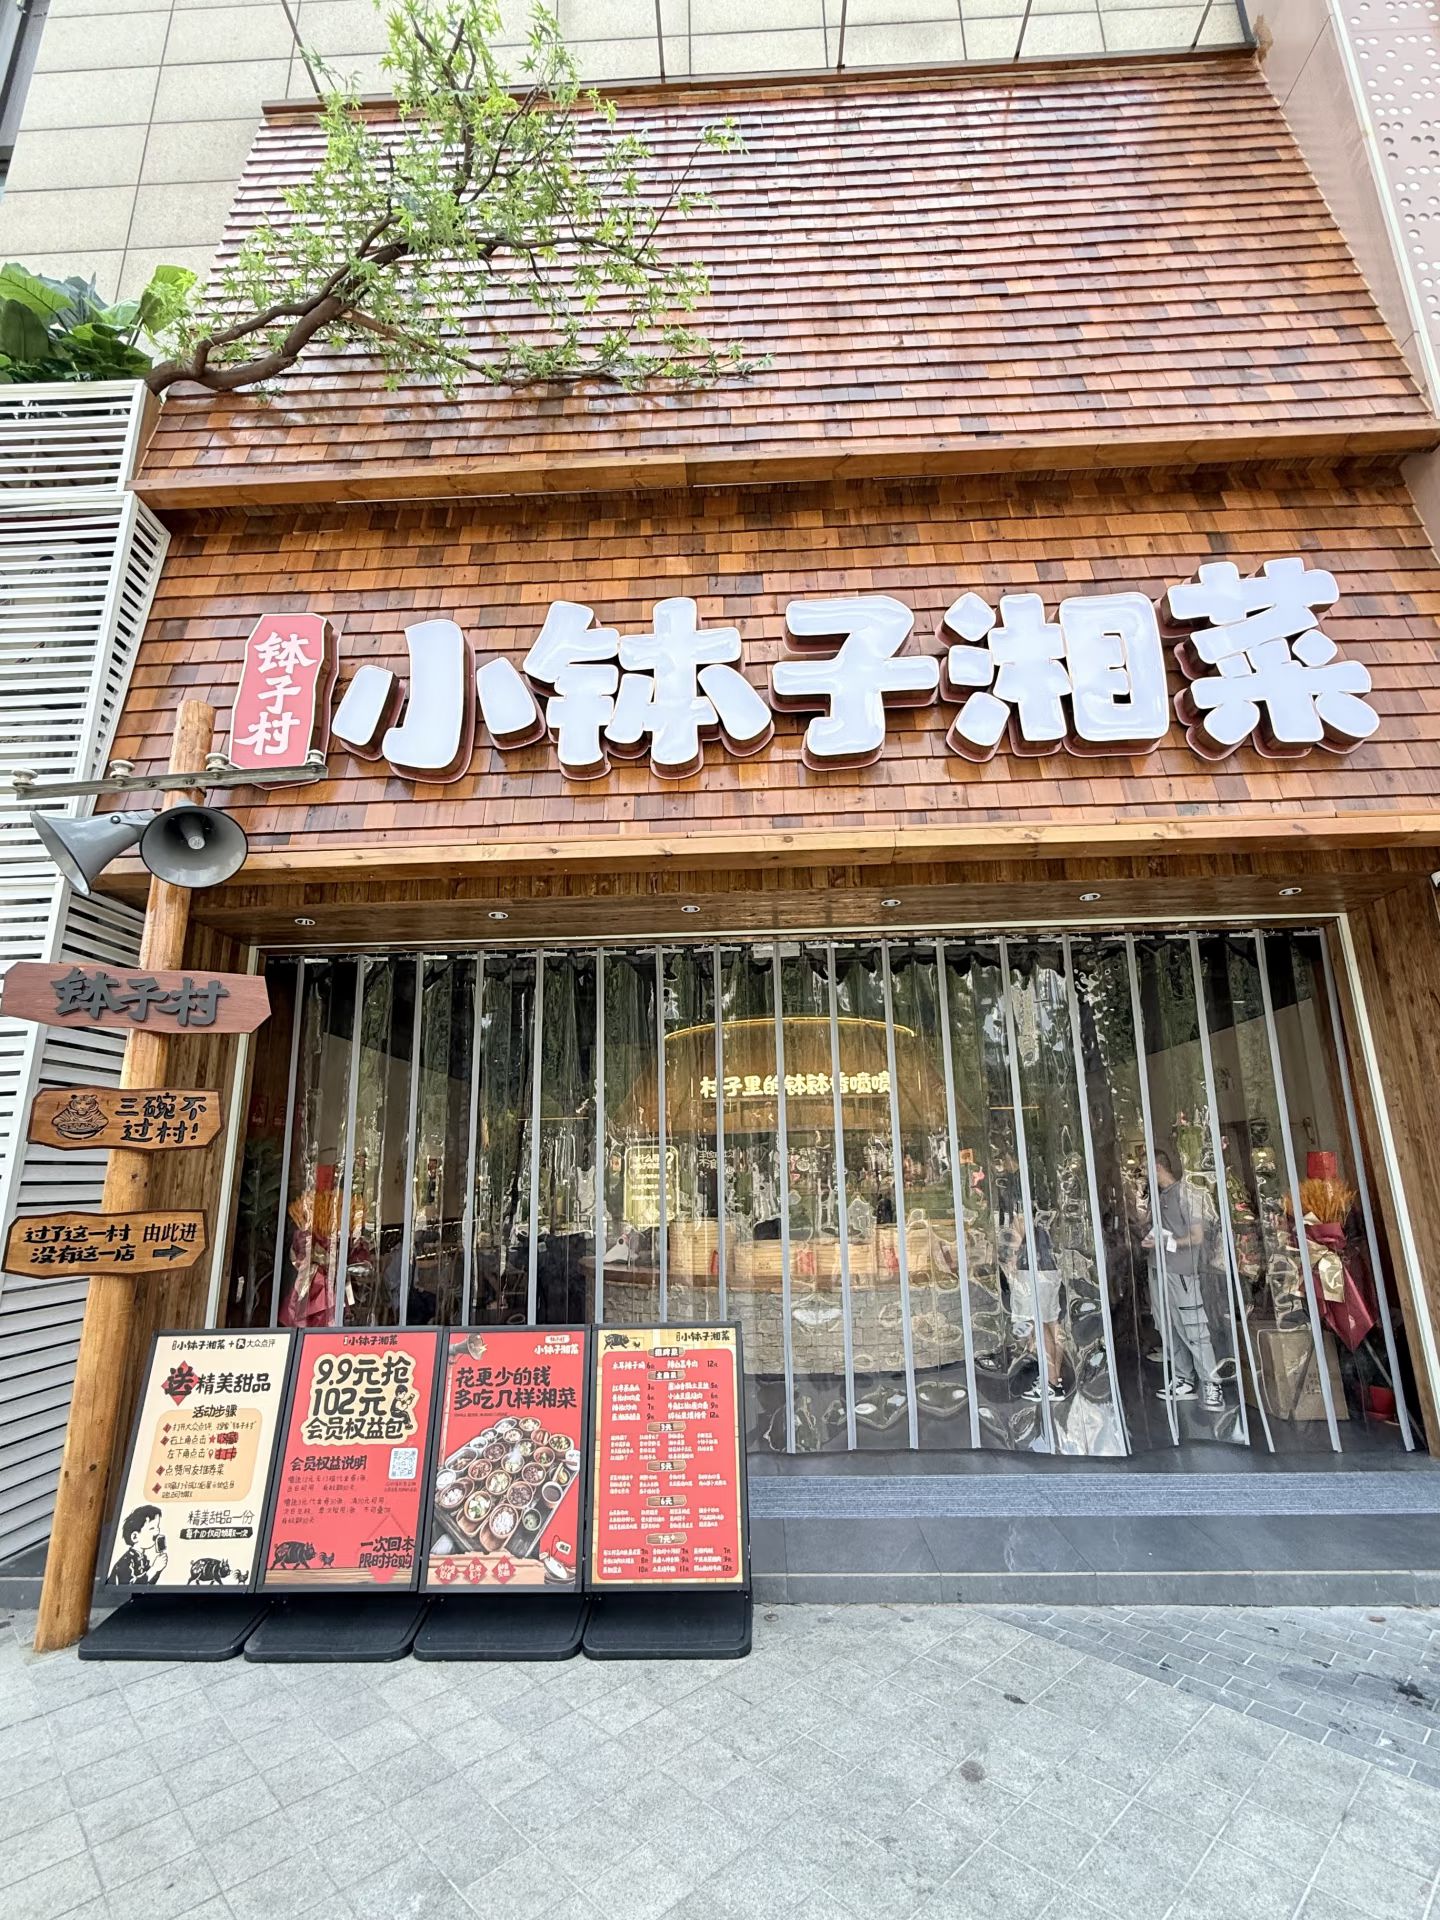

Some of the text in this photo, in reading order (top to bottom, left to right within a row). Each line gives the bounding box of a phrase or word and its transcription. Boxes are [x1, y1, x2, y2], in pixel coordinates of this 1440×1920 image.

[332, 557, 1382, 776] 小钵子湘菜
[234, 631, 318, 756] 钵子村
[51, 966, 230, 1027] 钵子村
[115, 1092, 207, 1119] 三碗不
[24, 1223, 132, 1244] 过了这一村
[143, 1222, 198, 1243] 由此进
[30, 1244, 136, 1263] 没有这一店
[176, 1339, 226, 1351] 小钵子湘菜
[247, 1338, 276, 1348] 大众点评
[348, 1335, 398, 1346] 小钵子湘菜
[681, 1331, 730, 1341] 小钵子湘菜
[534, 1344, 579, 1355] 小钵子湘菜
[316, 1356, 412, 1386] 9.9元抢
[456, 1365, 551, 1388] 花更少的钱
[312, 1387, 388, 1417] 102元
[454, 1387, 577, 1410] 多吃几样湘菜
[192, 1404, 238, 1418] 活动步骤
[305, 1417, 404, 1441] 会员权益包
[290, 1455, 367, 1471] 会员权益说明
[188, 1509, 255, 1525] 精美甜品一份
[360, 1536, 415, 1552] 一次回本
[359, 1553, 413, 1569] 限时抢购
